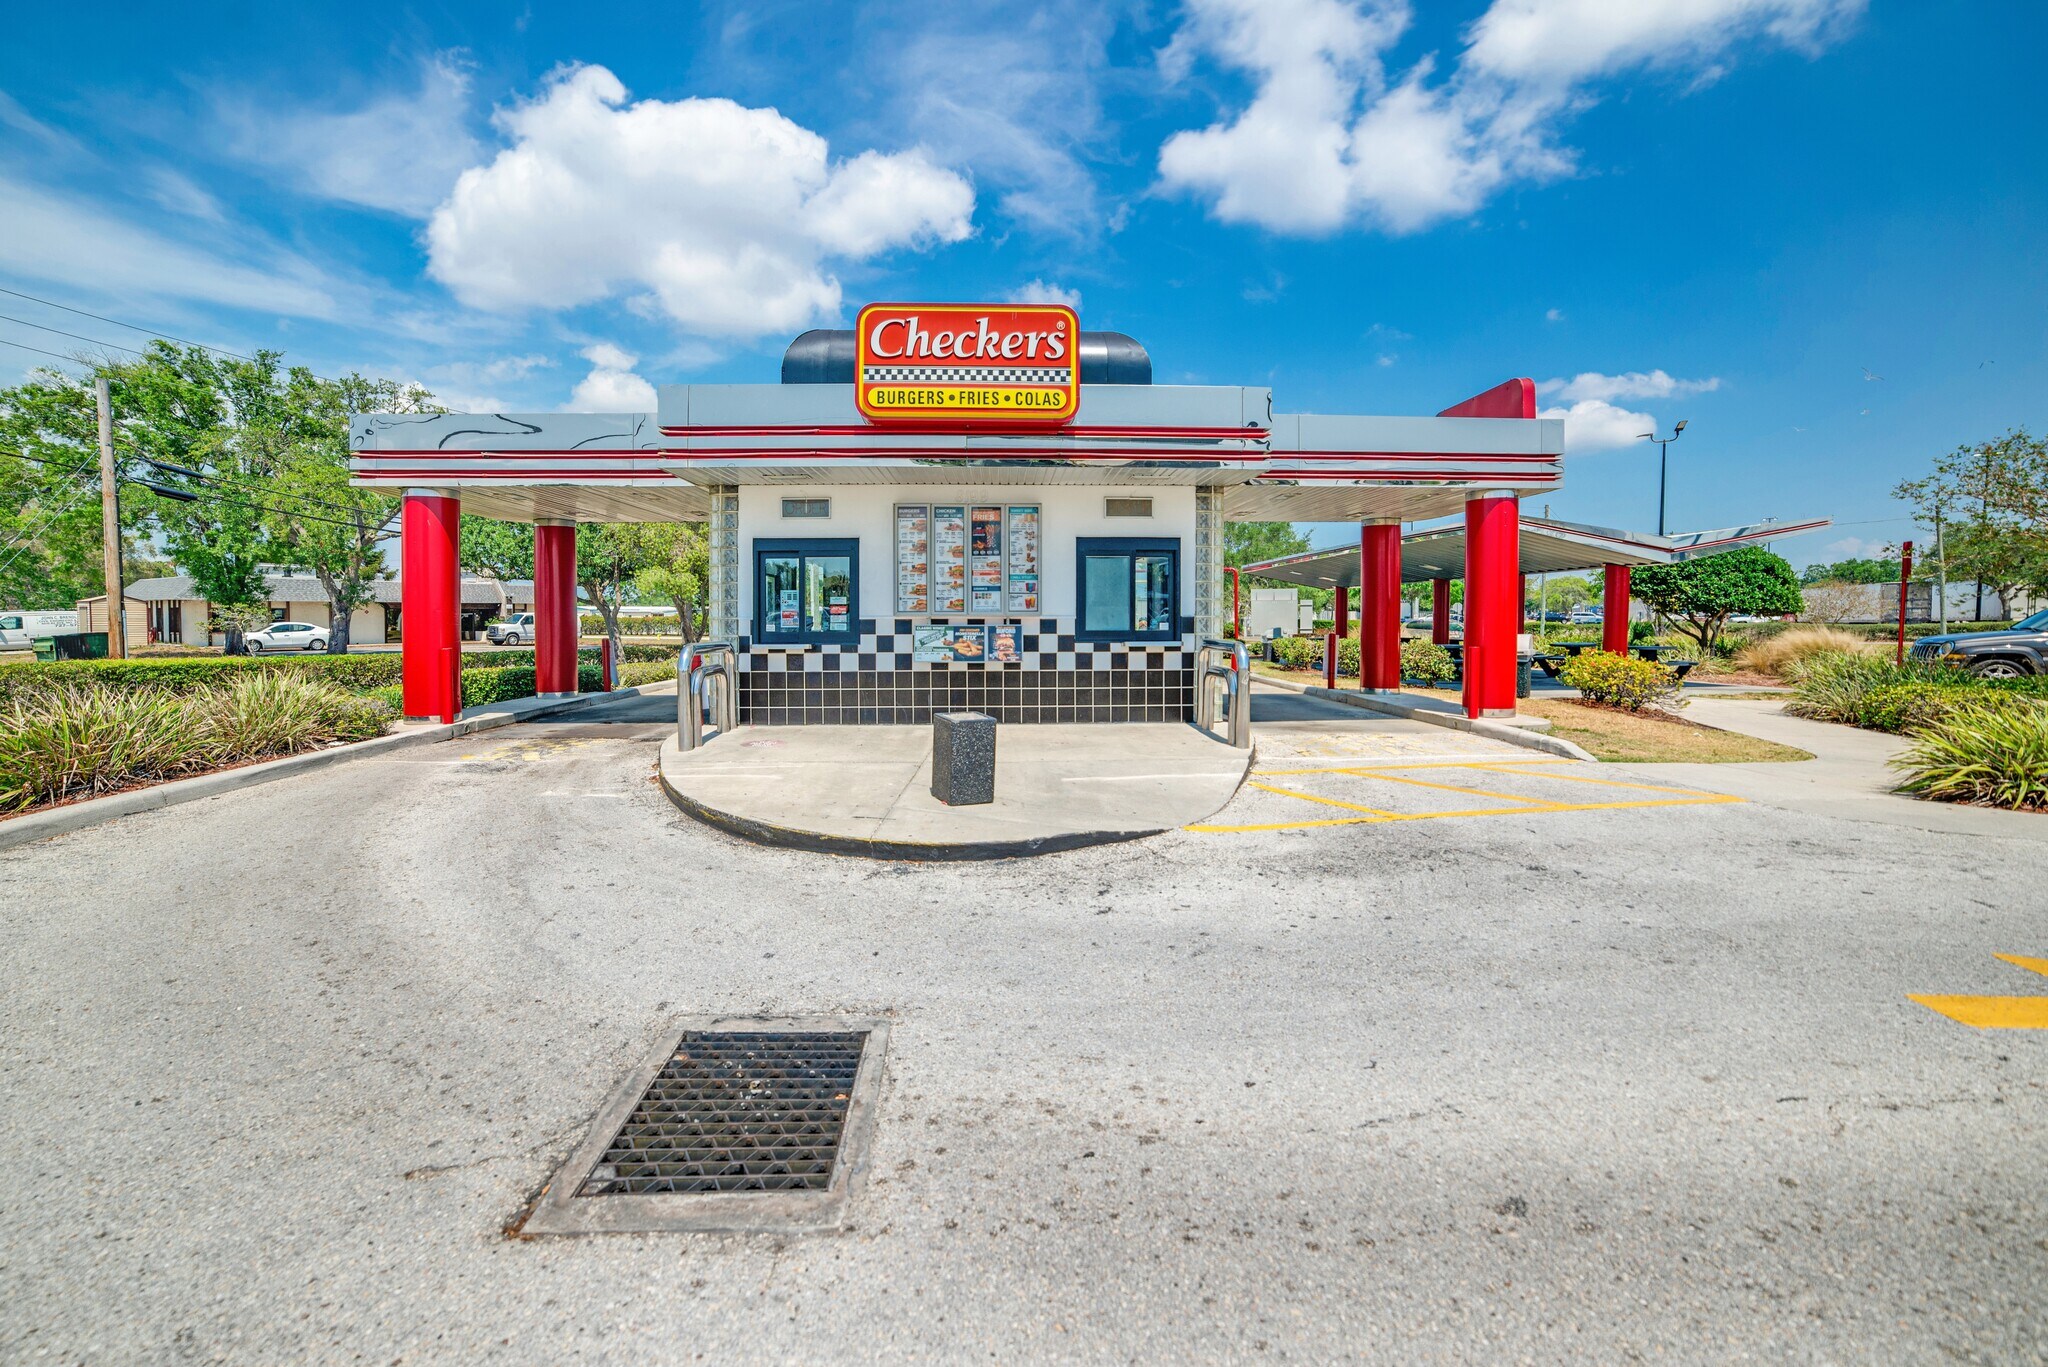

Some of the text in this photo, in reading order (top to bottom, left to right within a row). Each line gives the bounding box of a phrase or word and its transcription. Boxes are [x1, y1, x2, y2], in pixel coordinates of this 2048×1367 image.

[877, 391, 1060, 406] BURGERS FRIES COLAS
